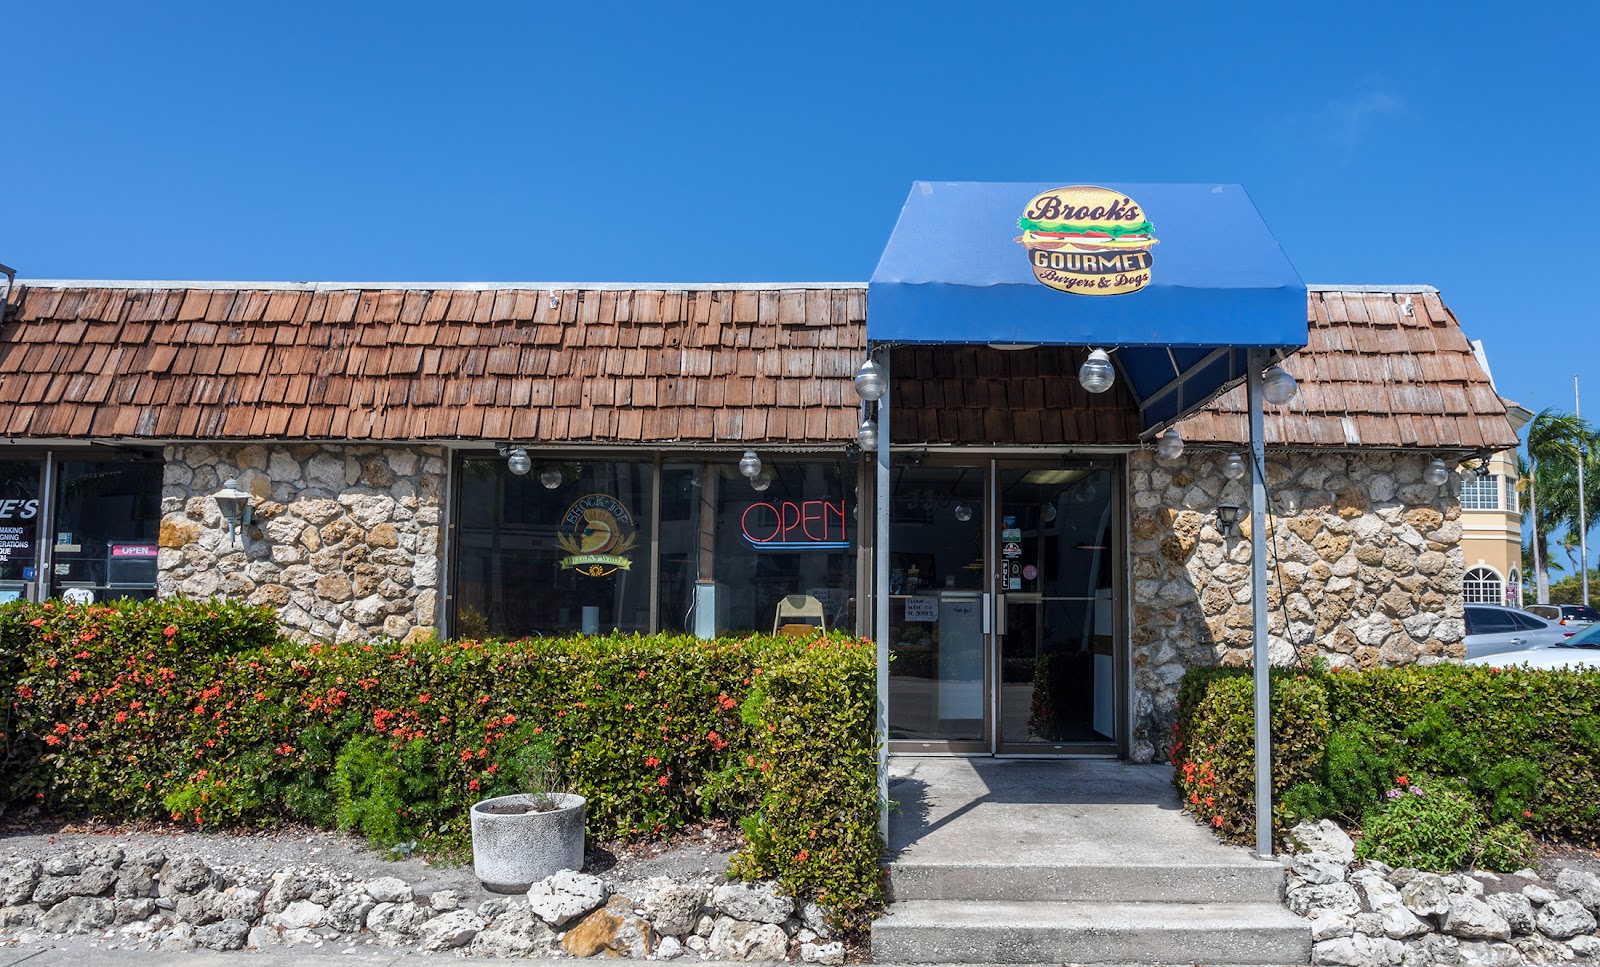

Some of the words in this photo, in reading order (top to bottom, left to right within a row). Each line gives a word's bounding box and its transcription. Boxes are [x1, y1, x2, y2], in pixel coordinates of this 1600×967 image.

[1027, 195, 1140, 221] Brook's
[1034, 251, 1147, 272] GOURMET
[1039, 269, 1095, 289] Burgers
[1097, 277, 1112, 289] &
[1113, 272, 1149, 287] Dogs
[0, 499, 39, 519] E'S
[566, 496, 605, 525] SHOCK
[607, 500, 629, 523] TOP
[742, 500, 845, 542] OPEN
[121, 546, 149, 554] OPEN
